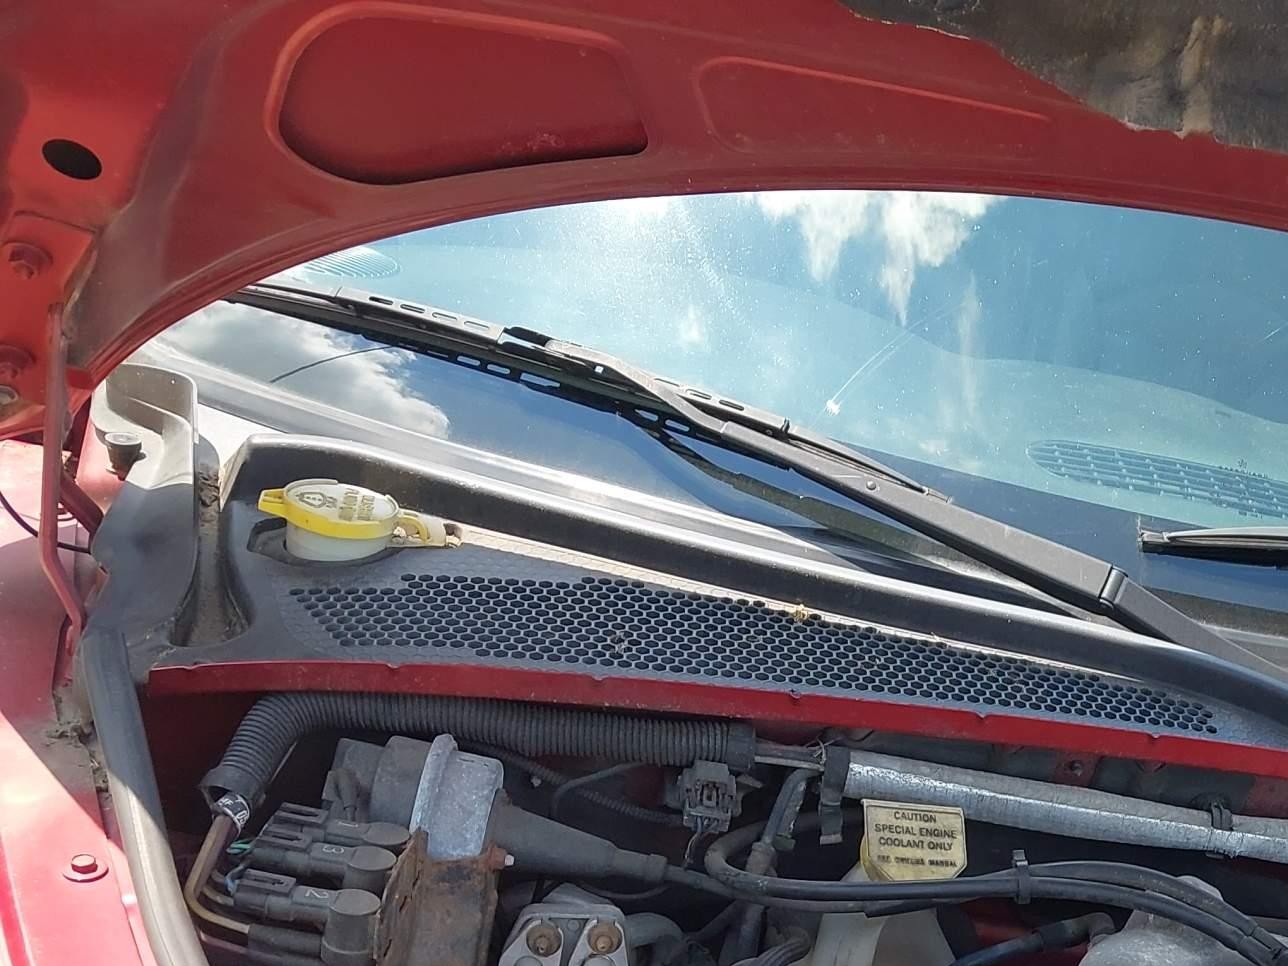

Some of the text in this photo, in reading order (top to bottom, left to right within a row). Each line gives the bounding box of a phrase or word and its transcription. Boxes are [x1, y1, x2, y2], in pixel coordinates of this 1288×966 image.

[894, 810, 937, 823] CAUTION
[874, 824, 958, 839] SPECIAL ENGINE
[879, 837, 953, 851] COOLANT ONLY
